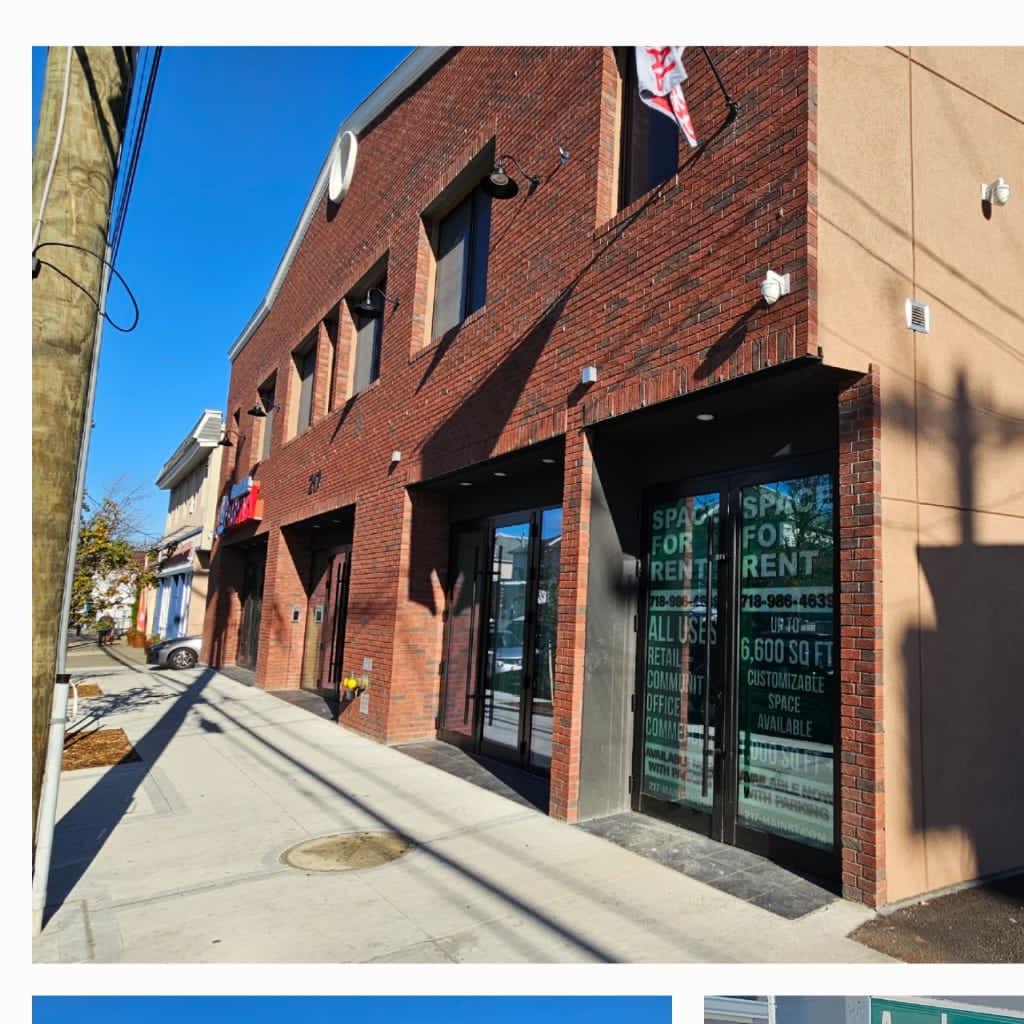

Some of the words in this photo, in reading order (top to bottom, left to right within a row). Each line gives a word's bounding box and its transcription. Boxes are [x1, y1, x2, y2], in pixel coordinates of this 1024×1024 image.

[743, 479, 833, 519] SPACE
[652, 532, 693, 556] FOR
[650, 559, 708, 582] RENT
[743, 550, 819, 577] RENT
[649, 615, 674, 642] ALL
[679, 616, 718, 646] USES
[648, 646, 681, 668] RETAIL
[741, 637, 784, 664] 6,600
[788, 640, 809, 666] SQ
[814, 641, 833, 668] FT
[647, 669, 707, 696] COMMUNIT
[747, 669, 825, 693] CUSTOMIZABLE
[646, 693, 682, 717] OFFICE
[768, 693, 801, 713] SPACE
[757, 713, 814, 737] AVAILABLE
